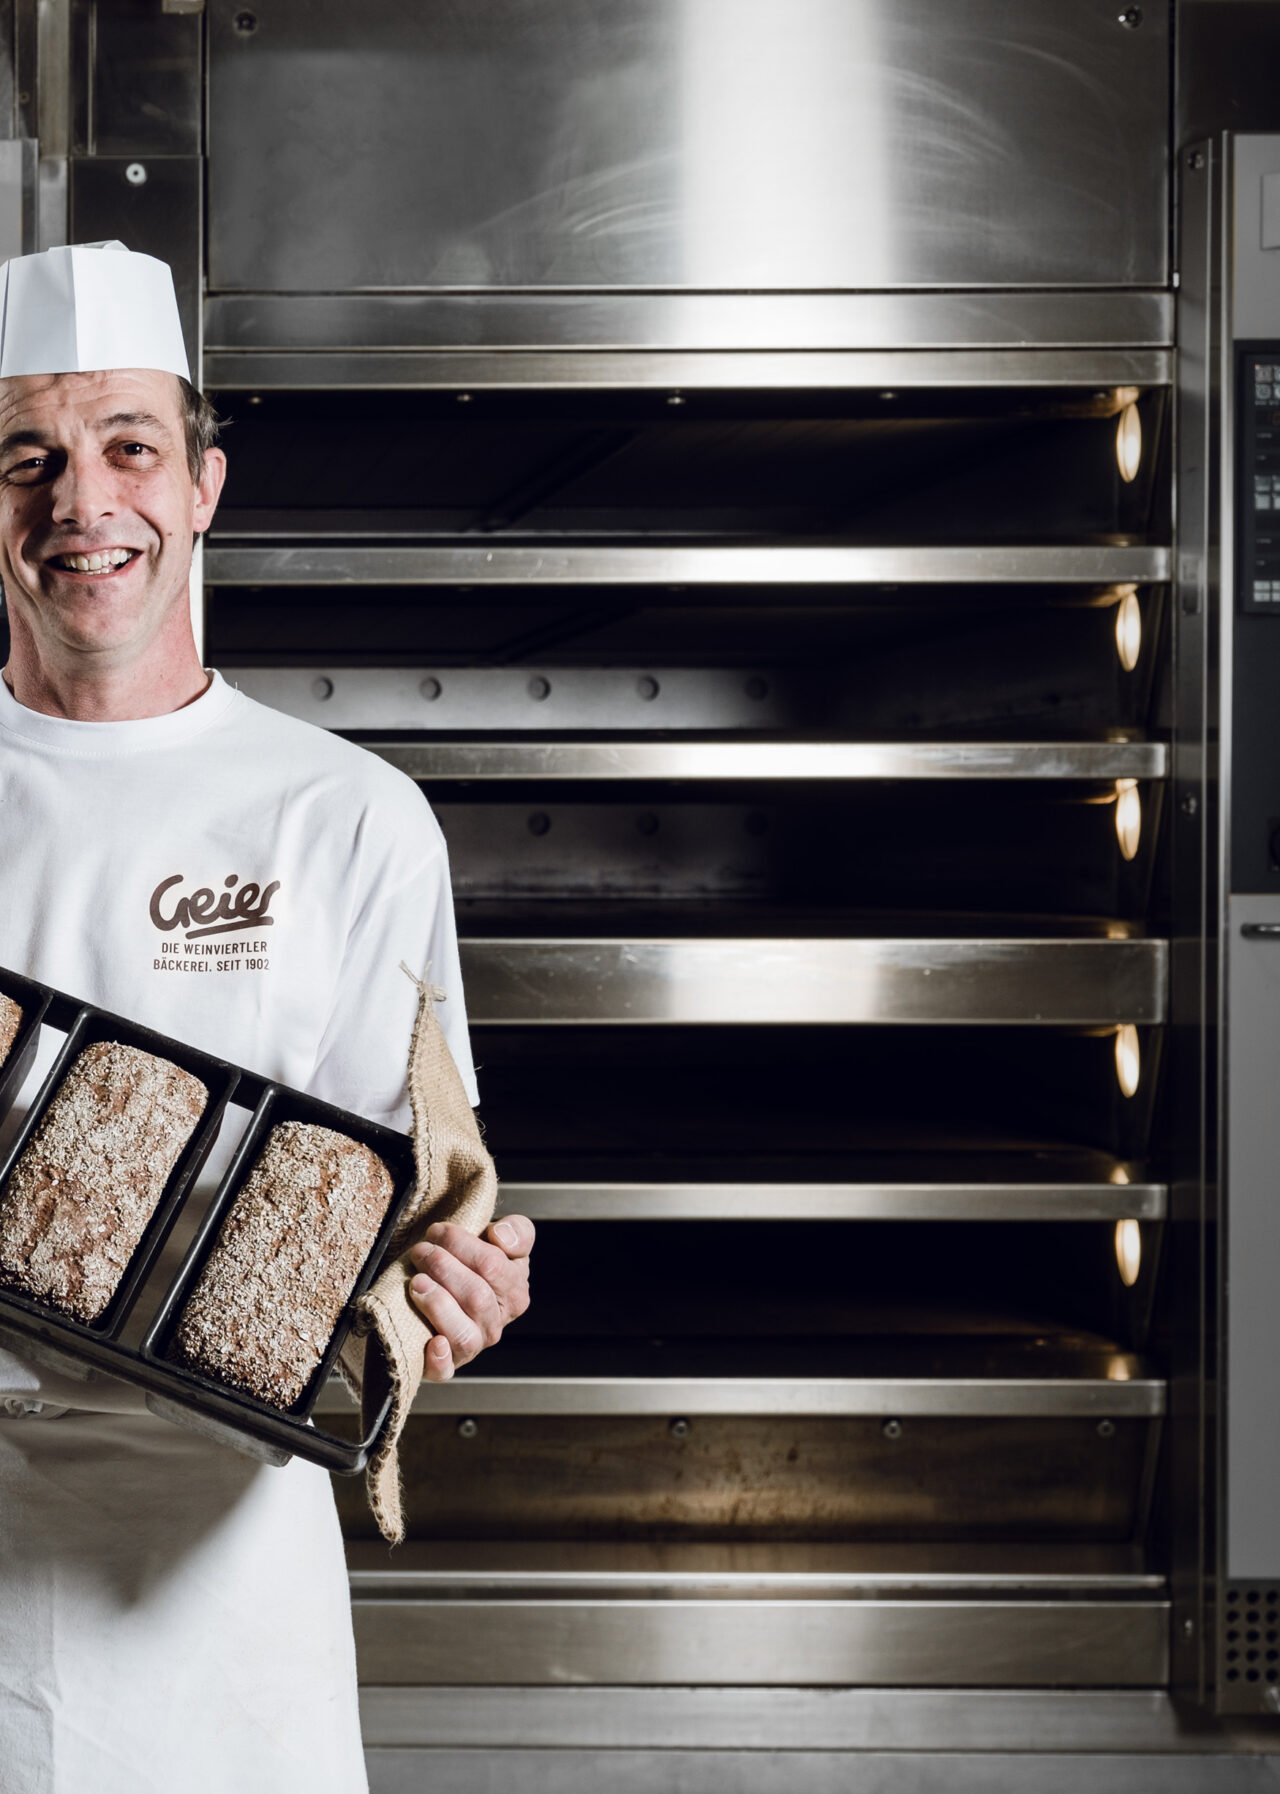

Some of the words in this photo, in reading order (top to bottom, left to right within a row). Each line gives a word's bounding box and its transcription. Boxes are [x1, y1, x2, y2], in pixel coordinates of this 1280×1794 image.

[149, 874, 281, 935] Geier
[161, 942, 180, 954] DIE
[184, 941, 268, 955] WEINVIERTLER
[153, 957, 212, 972] BÄCKEREI.
[216, 959, 241, 972] SEIT
[245, 958, 270, 971] 1902
